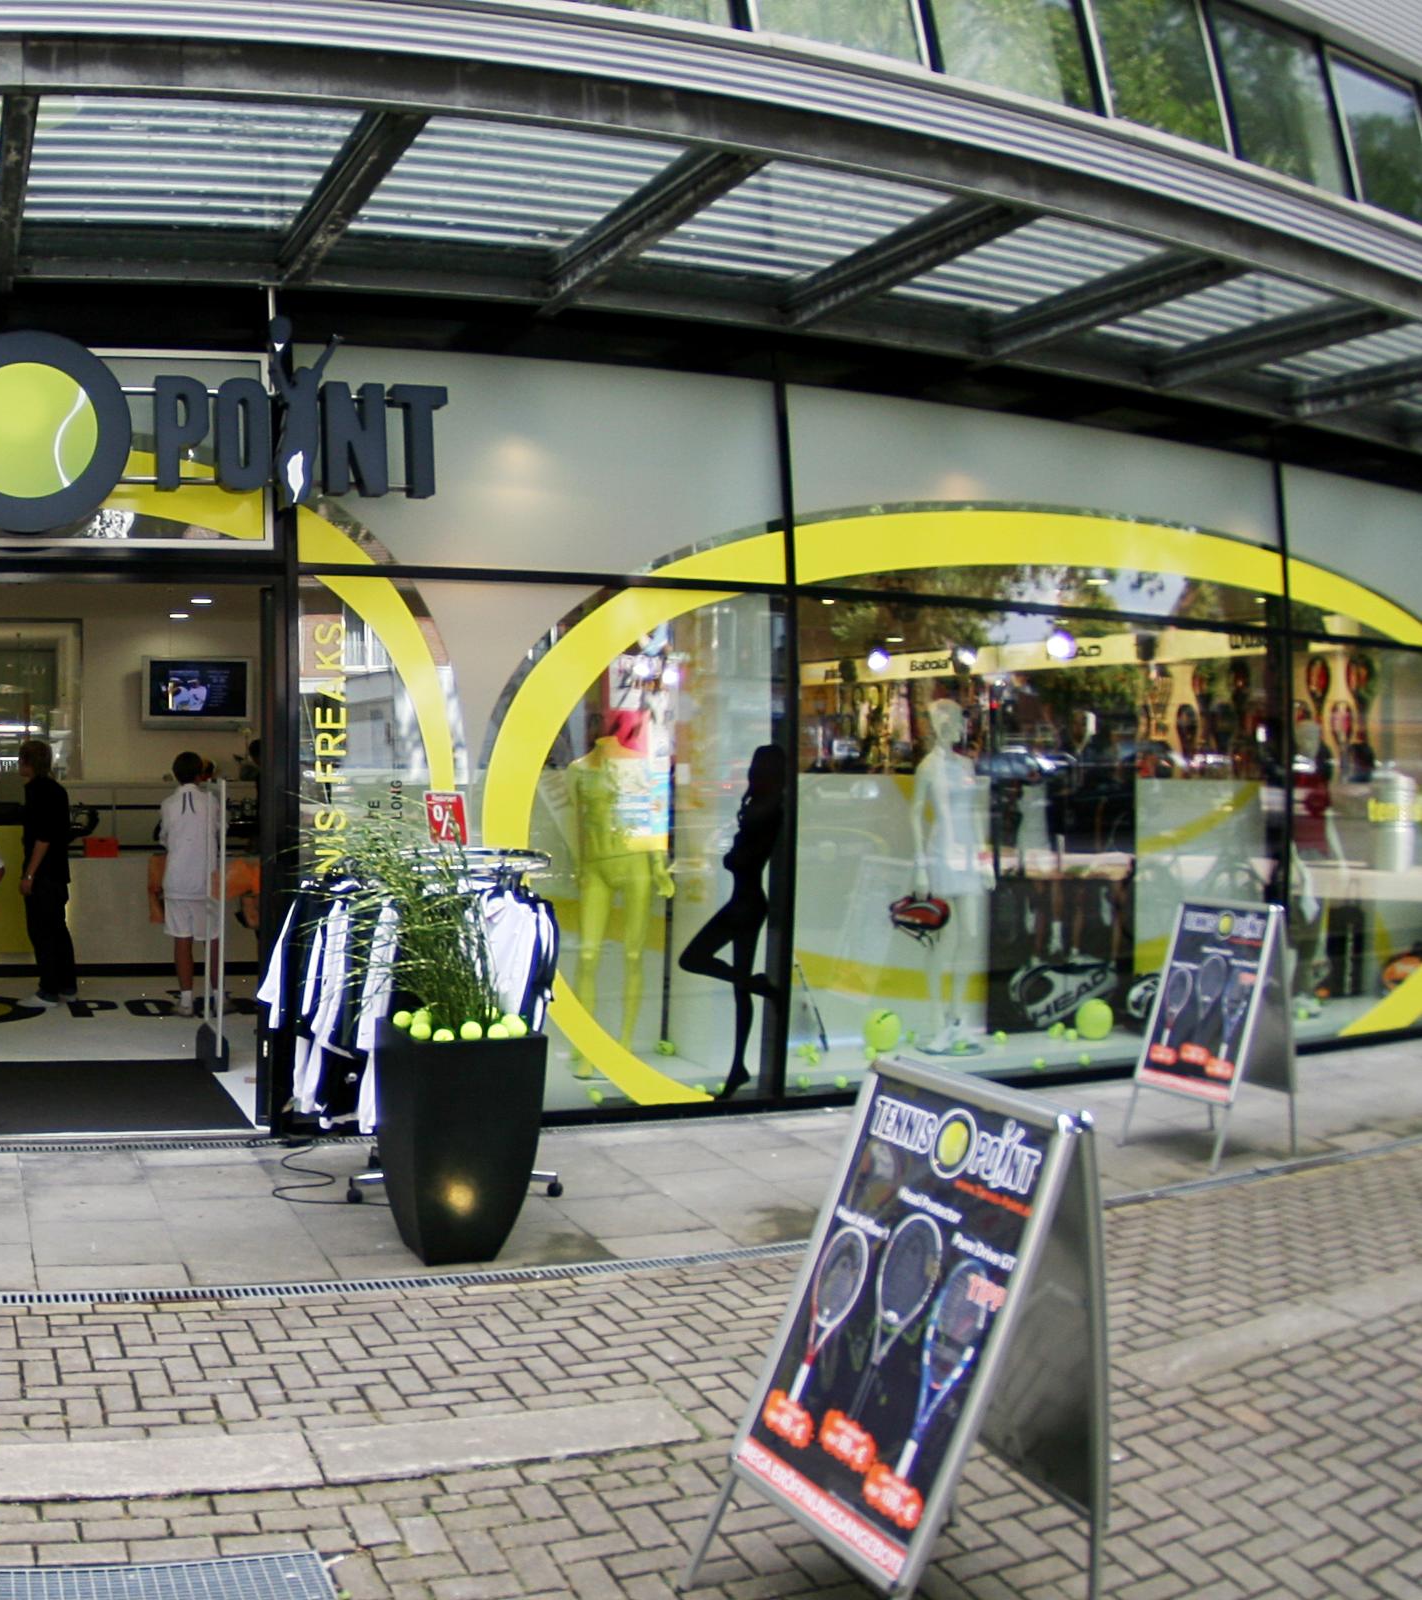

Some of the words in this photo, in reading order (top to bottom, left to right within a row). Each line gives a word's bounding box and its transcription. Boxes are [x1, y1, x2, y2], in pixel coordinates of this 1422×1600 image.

[154, 316, 449, 508] POINT
[314, 622, 347, 785] FREAKS
[314, 808, 348, 874] NIS
[869, 1094, 939, 1154] TENNIS
